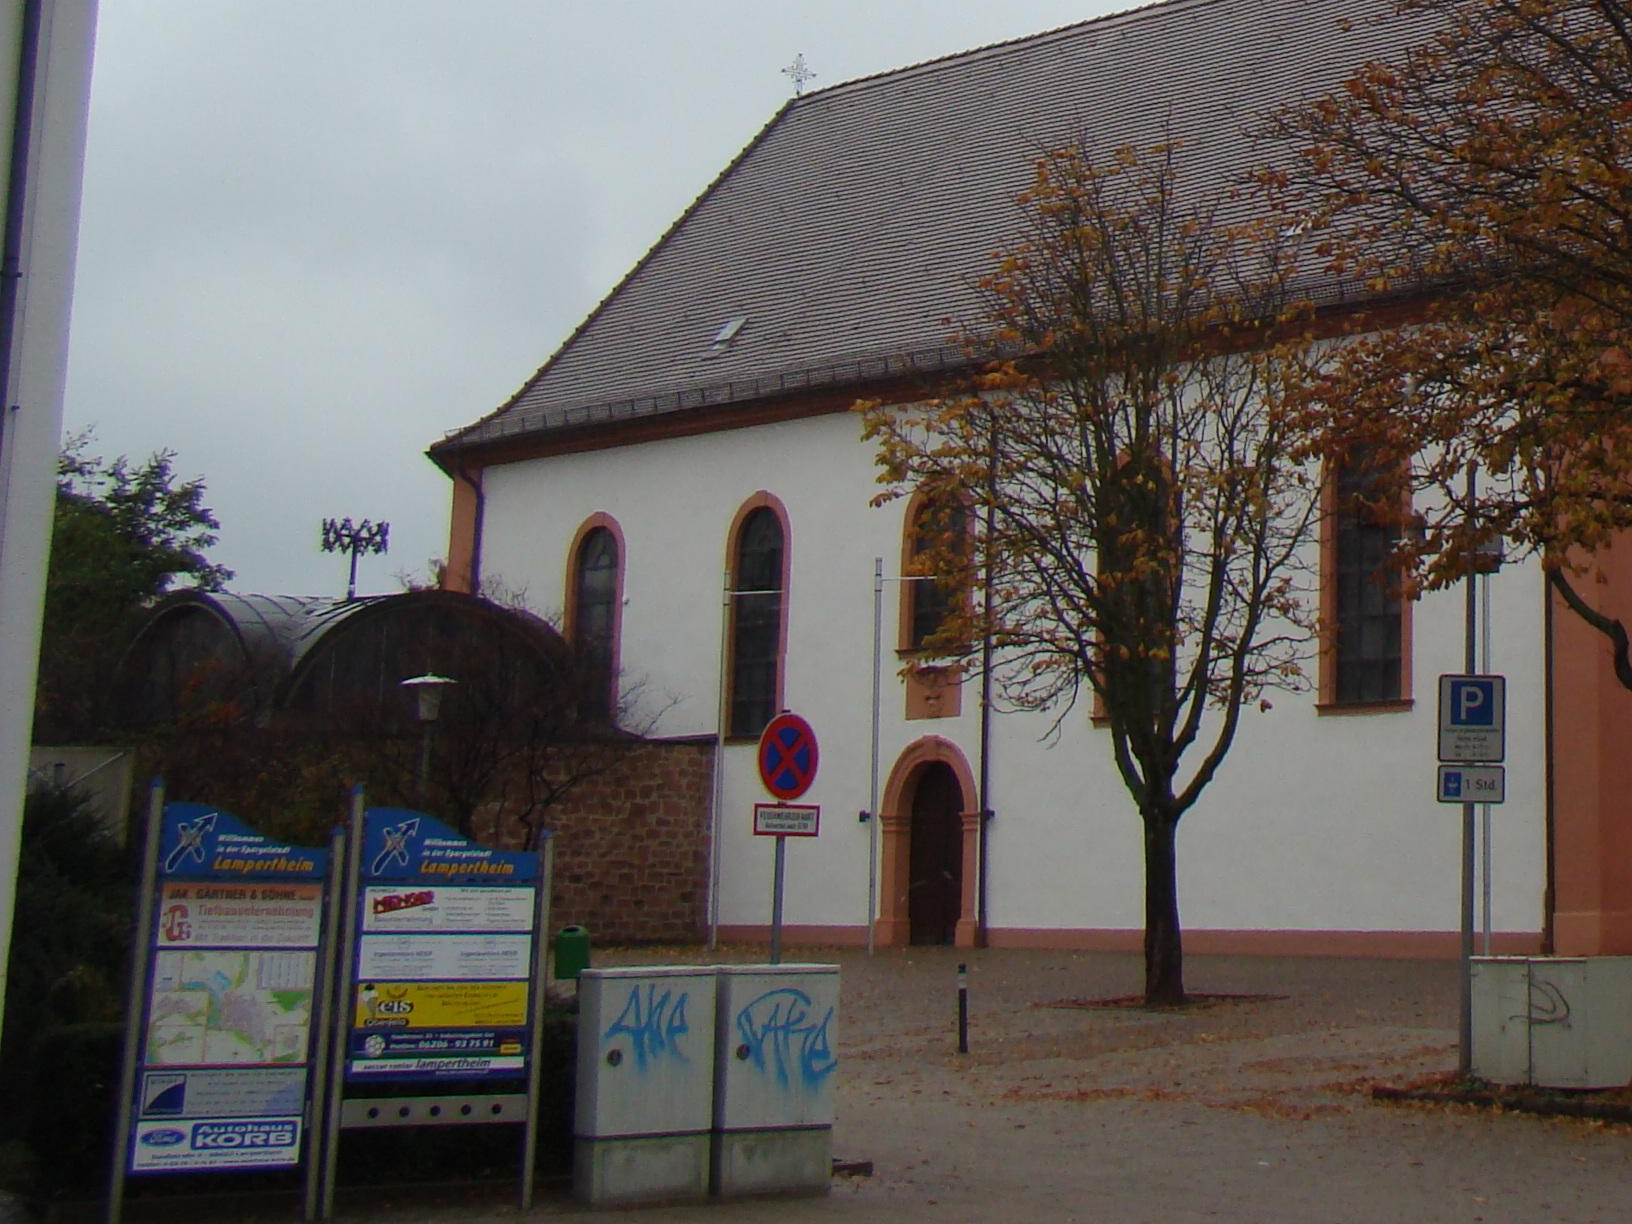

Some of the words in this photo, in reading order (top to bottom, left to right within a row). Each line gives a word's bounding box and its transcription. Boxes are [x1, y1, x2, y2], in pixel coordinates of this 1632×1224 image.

[1460, 686, 1484, 721] P
[1465, 778, 1471, 791] 1
[213, 856, 315, 873] Lampertheim
[420, 859, 514, 876] Lampertheim
[415, 1058, 492, 1071] lampertheim
[199, 1123, 294, 1134] Autohaus
[195, 1131, 294, 1148] KORB
